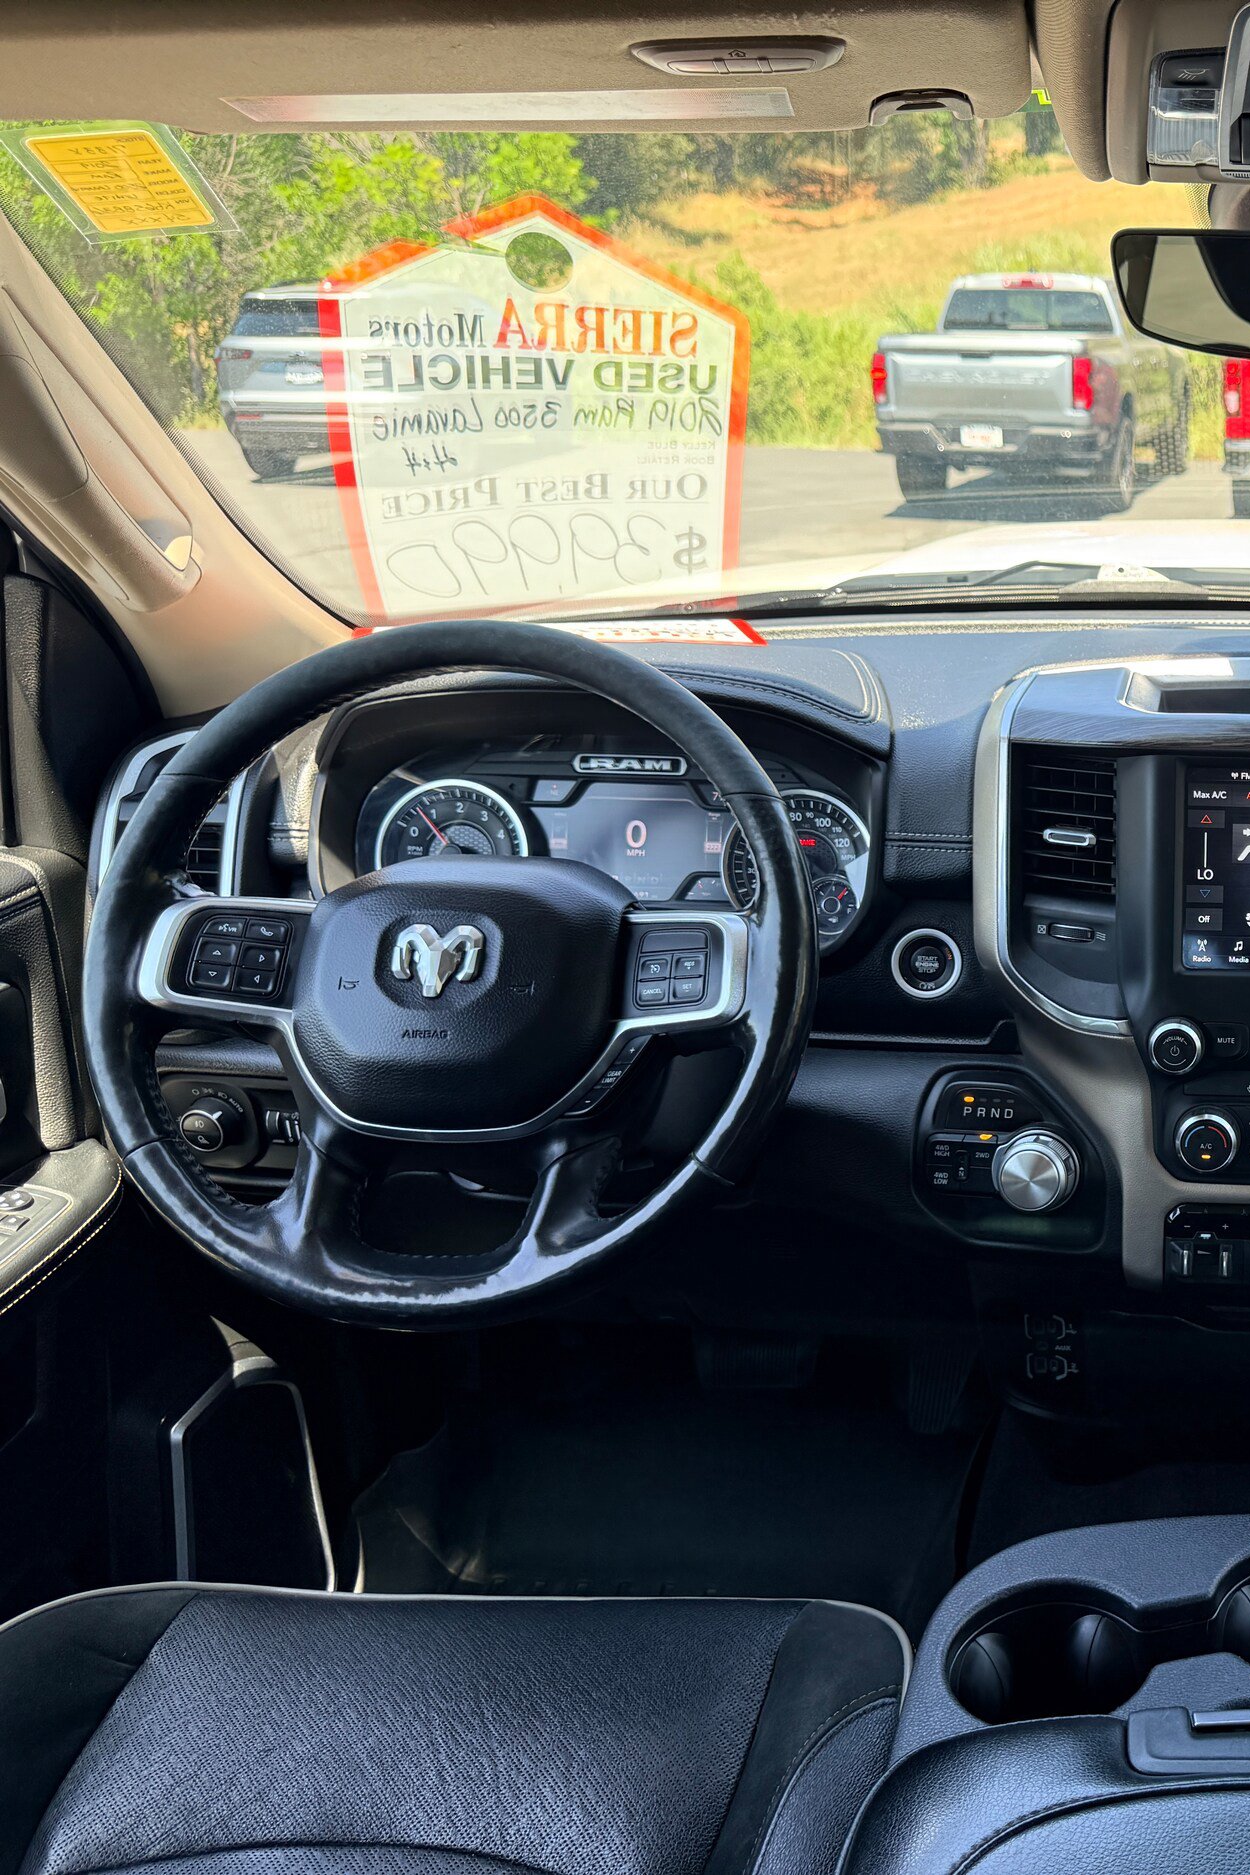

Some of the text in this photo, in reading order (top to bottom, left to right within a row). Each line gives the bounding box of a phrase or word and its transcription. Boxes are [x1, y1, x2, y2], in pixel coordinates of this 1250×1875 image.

[589, 757, 673, 771] RAM
[1193, 790, 1227, 800] Max A/C
[455, 802, 464, 813] 2
[430, 808, 437, 820] 1
[481, 810, 489, 822] 3
[814, 818, 831, 828] 100
[410, 827, 419, 838] 0
[497, 831, 505, 840] 4
[626, 819, 647, 849] 0
[834, 838, 850, 847] 120
[626, 849, 646, 857] MPH
[1197, 869, 1214, 880] LO
[1198, 914, 1211, 923] Off
[1192, 955, 1211, 963] Radio
[1228, 955, 1249, 964] Media
[402, 1029, 449, 1039] AIRBAG
[1217, 1037, 1235, 1045] MUTE
[229, 1098, 244, 1113] AUTO
[963, 1106, 1014, 1119] P R N D
